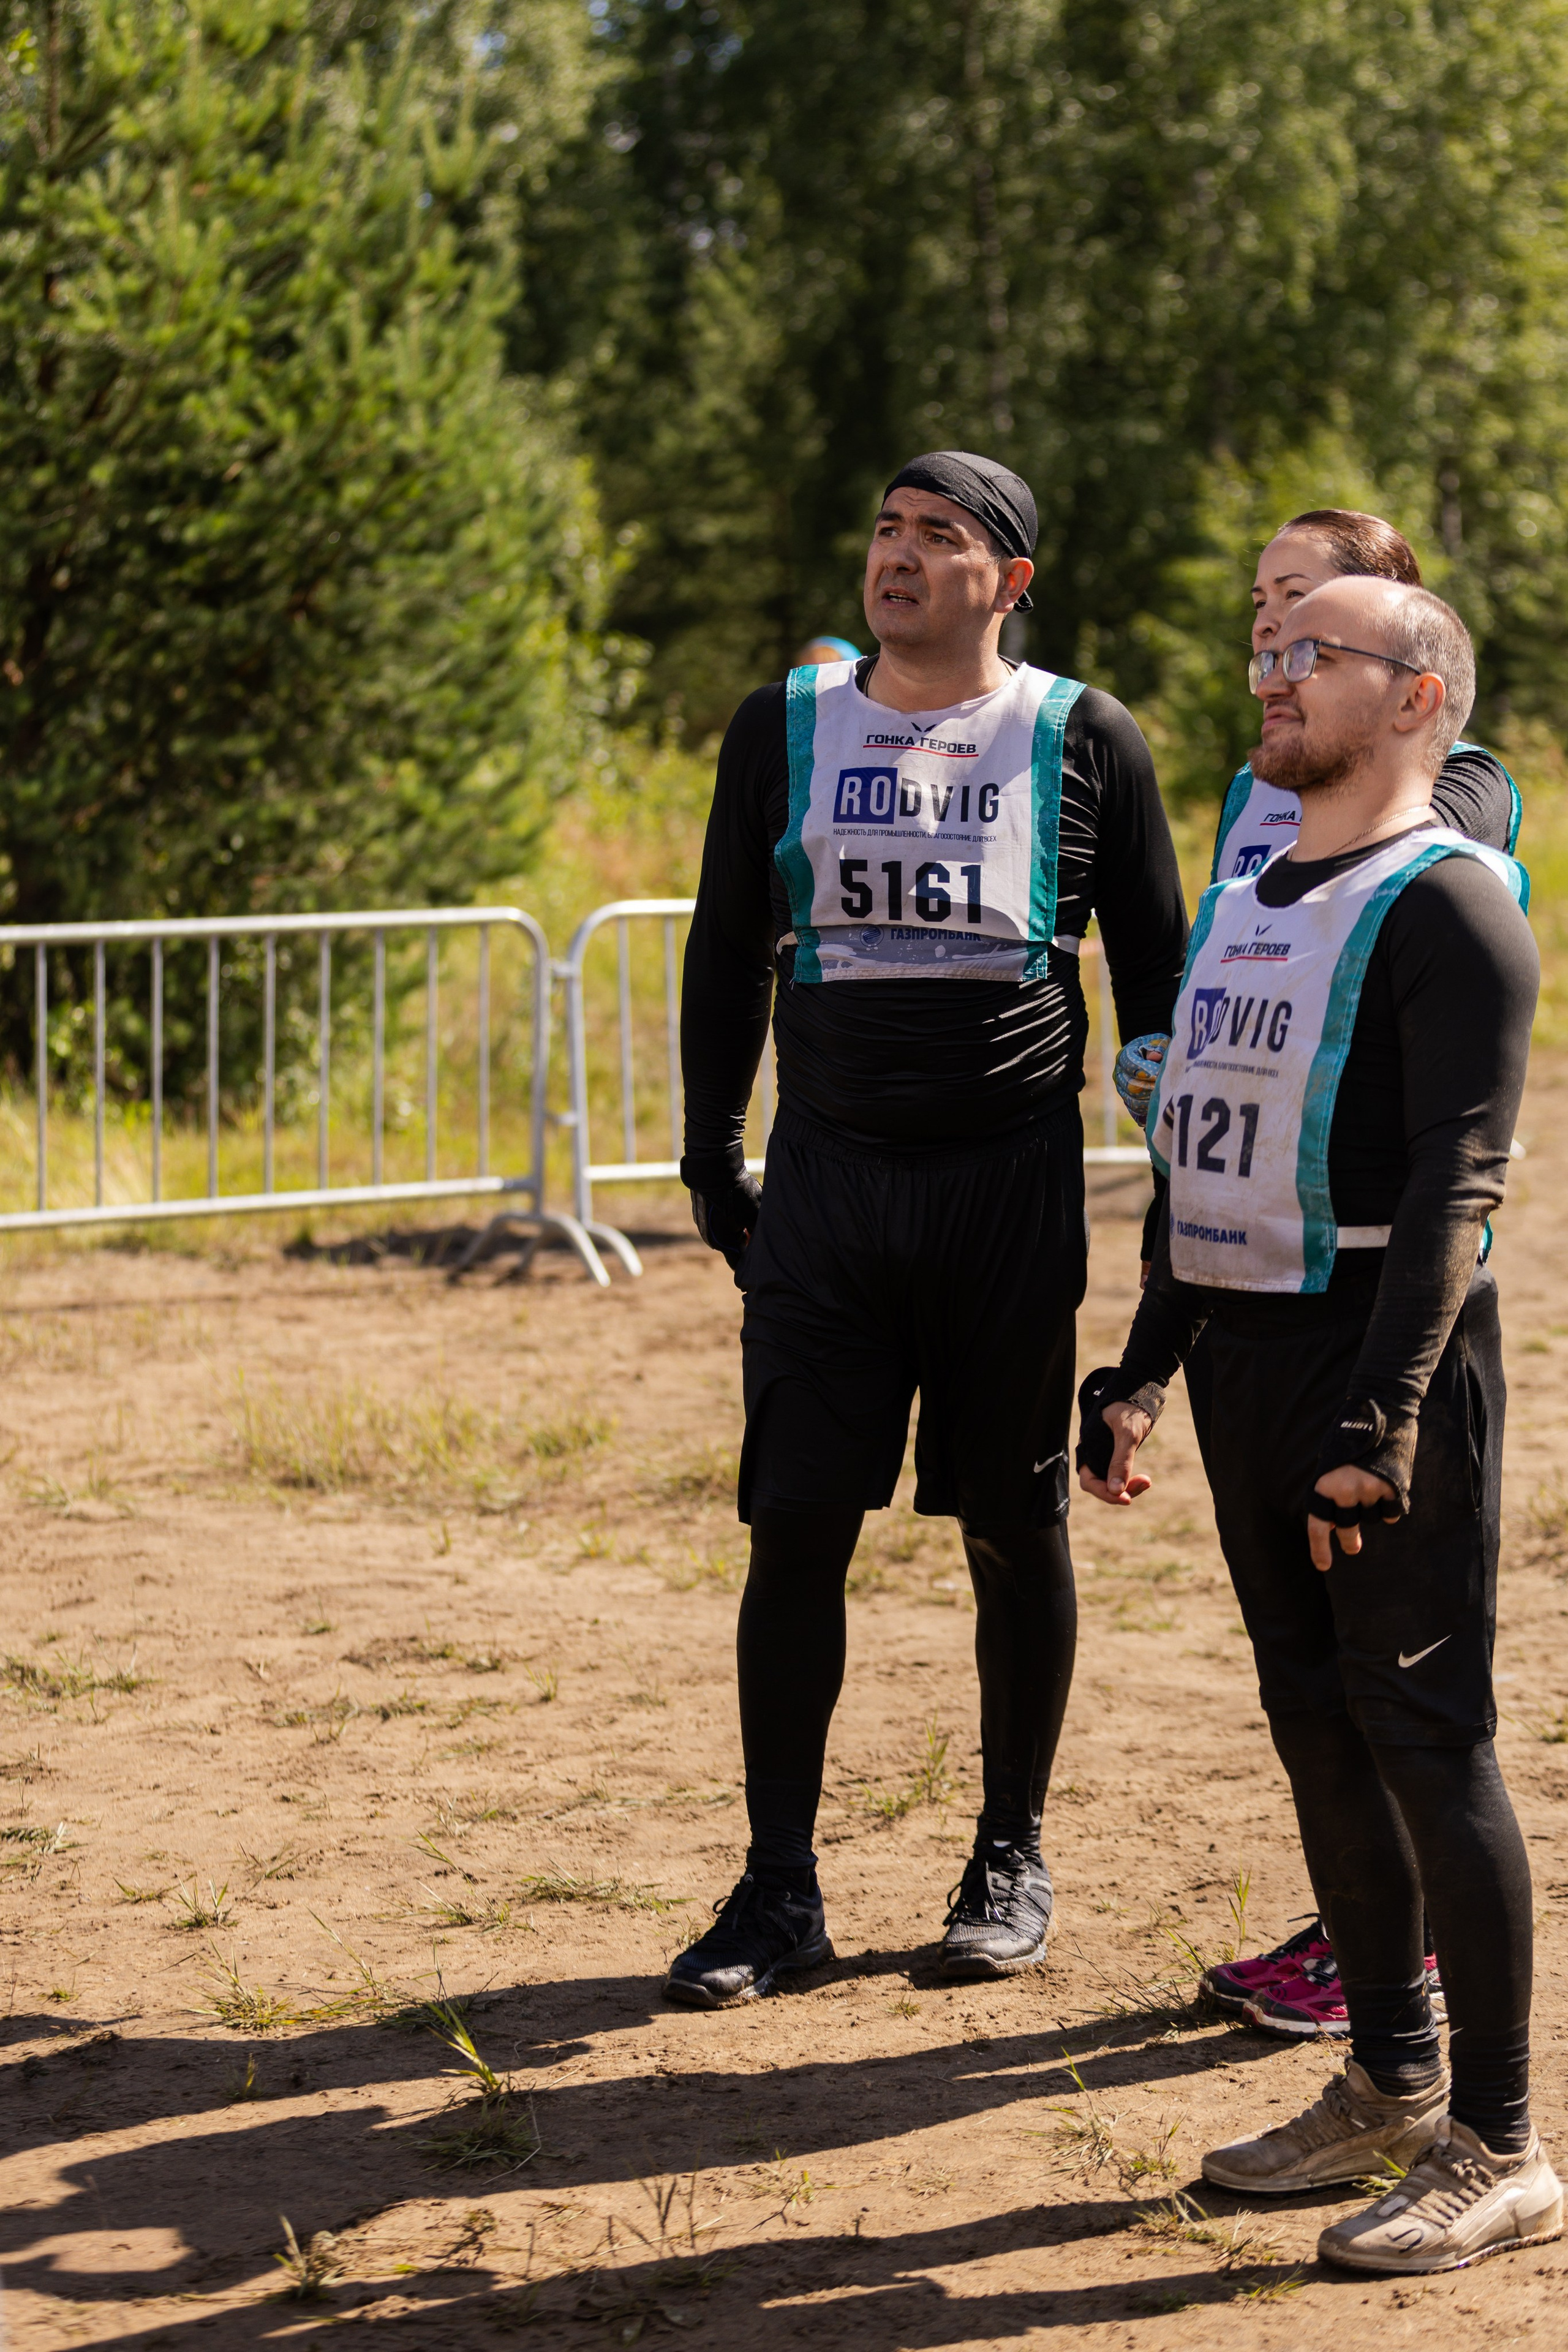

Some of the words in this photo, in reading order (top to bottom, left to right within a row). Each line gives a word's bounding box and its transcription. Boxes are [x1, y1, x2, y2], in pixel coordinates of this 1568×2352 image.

[866, 734, 915, 746] ГОНКА
[920, 737, 977, 754] ГЕРОЕВ
[840, 775, 1000, 823] RODVIG
[1263, 810, 1296, 822] ГОНКА
[927, 832, 971, 842] БЛАГОСОСТОЯНИЕ
[839, 859, 981, 924] 5161
[891, 927, 982, 941] ГАЗПРОМБАНК
[1248, 942, 1291, 956] ГЕРОЕВ
[1177, 1220, 1247, 1245] ГАЗПРОМБАНК
